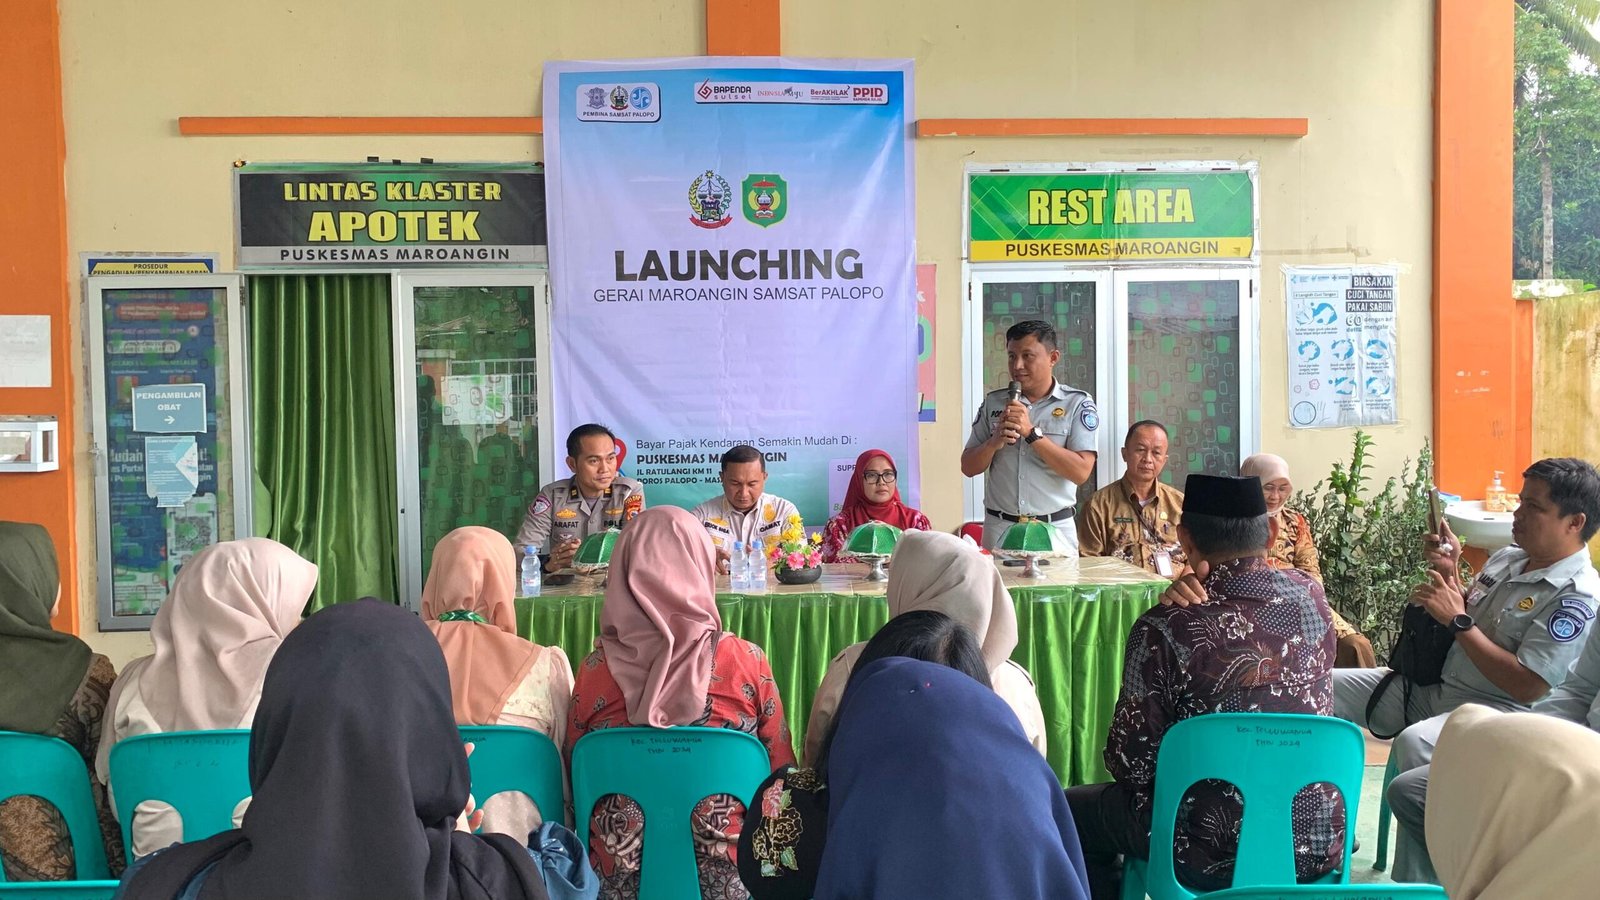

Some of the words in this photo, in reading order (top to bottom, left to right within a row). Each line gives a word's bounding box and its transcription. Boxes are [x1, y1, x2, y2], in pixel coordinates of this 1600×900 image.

[853, 87, 884, 97] PPID
[283, 182, 378, 201] LINTAS
[386, 181, 502, 201] KLASTER
[1027, 188, 1108, 225] REST
[1113, 188, 1195, 224] AREA
[308, 210, 481, 242] APOTEK
[280, 248, 389, 261] PUSKESMAS
[396, 247, 510, 261] MAROANGIN
[1005, 242, 1111, 257] PUSKESMAS
[1115, 240, 1219, 256] MAROANGIN
[614, 248, 864, 282] LAUNCHING
[1353, 276, 1392, 287] BIASAKAN
[593, 288, 645, 302] GERAI
[649, 287, 749, 302] MAROANGIN
[753, 287, 817, 301] SAMSAT
[821, 286, 885, 300] PALOPO
[1347, 290, 1364, 299] CUCI
[1366, 290, 1392, 299] TANGAN
[1347, 302, 1368, 312] PAKAI
[1369, 302, 1392, 312] SABUN
[136, 391, 202, 399] PENGAMBILAN
[636, 439, 666, 451] Bayar
[668, 439, 697, 451] Pajak
[700, 437, 755, 448] Kendaraan
[758, 436, 801, 447] Semakin
[804, 436, 838, 446] Mudah
[841, 435, 852, 445] Di
[636, 453, 705, 465] PUSKESMAS
[636, 468, 644, 476] JL
[553, 520, 579, 528] ARAFAT
